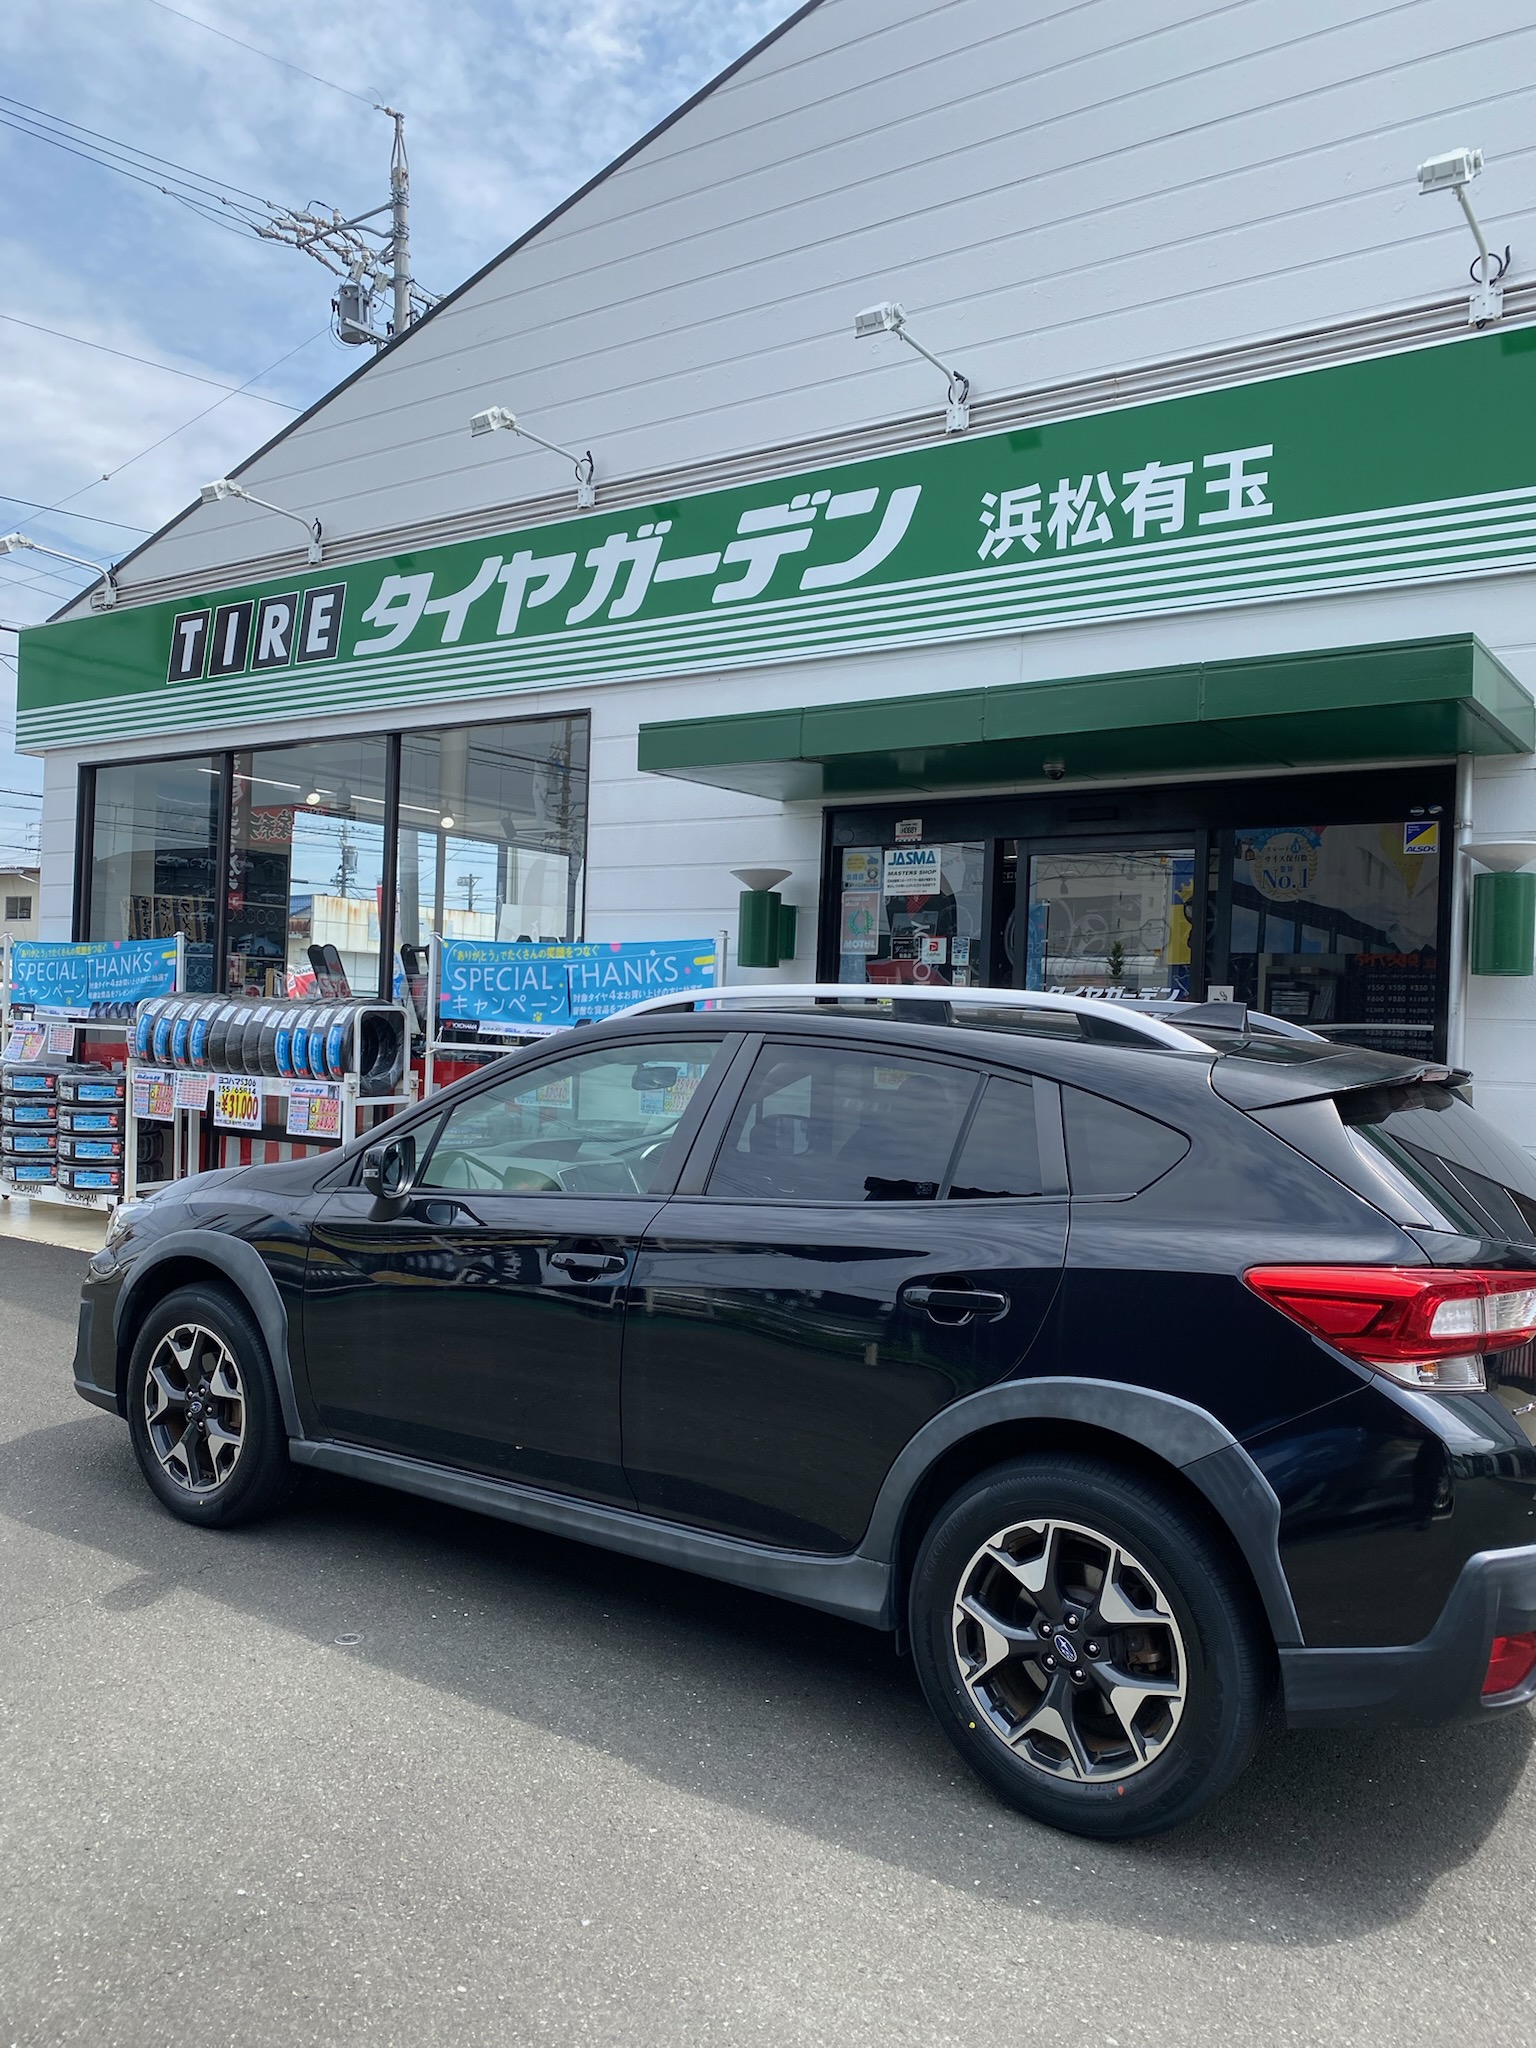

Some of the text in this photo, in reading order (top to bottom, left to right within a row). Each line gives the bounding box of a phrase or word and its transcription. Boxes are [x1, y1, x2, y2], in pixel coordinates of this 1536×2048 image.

[977, 444, 1273, 561] 浜松有玉
[353, 485, 922, 656] タイヤガーデン
[180, 598, 336, 673] TIRE
[888, 850, 936, 865] JASMA
[1262, 867, 1310, 889] No.1
[843, 940, 876, 949] MOTUL
[18, 952, 153, 981] SPECIAL THANKS
[451, 956, 679, 992] SPECIAL THANKS
[18, 984, 87, 1000] キャンペーン
[1048, 986, 1181, 1001] タイヤガーデン
[452, 994, 566, 1016] キャンペーン
[219, 1077, 257, 1087] ヨコハマS306
[221, 1094, 259, 1121] ¥31,000
